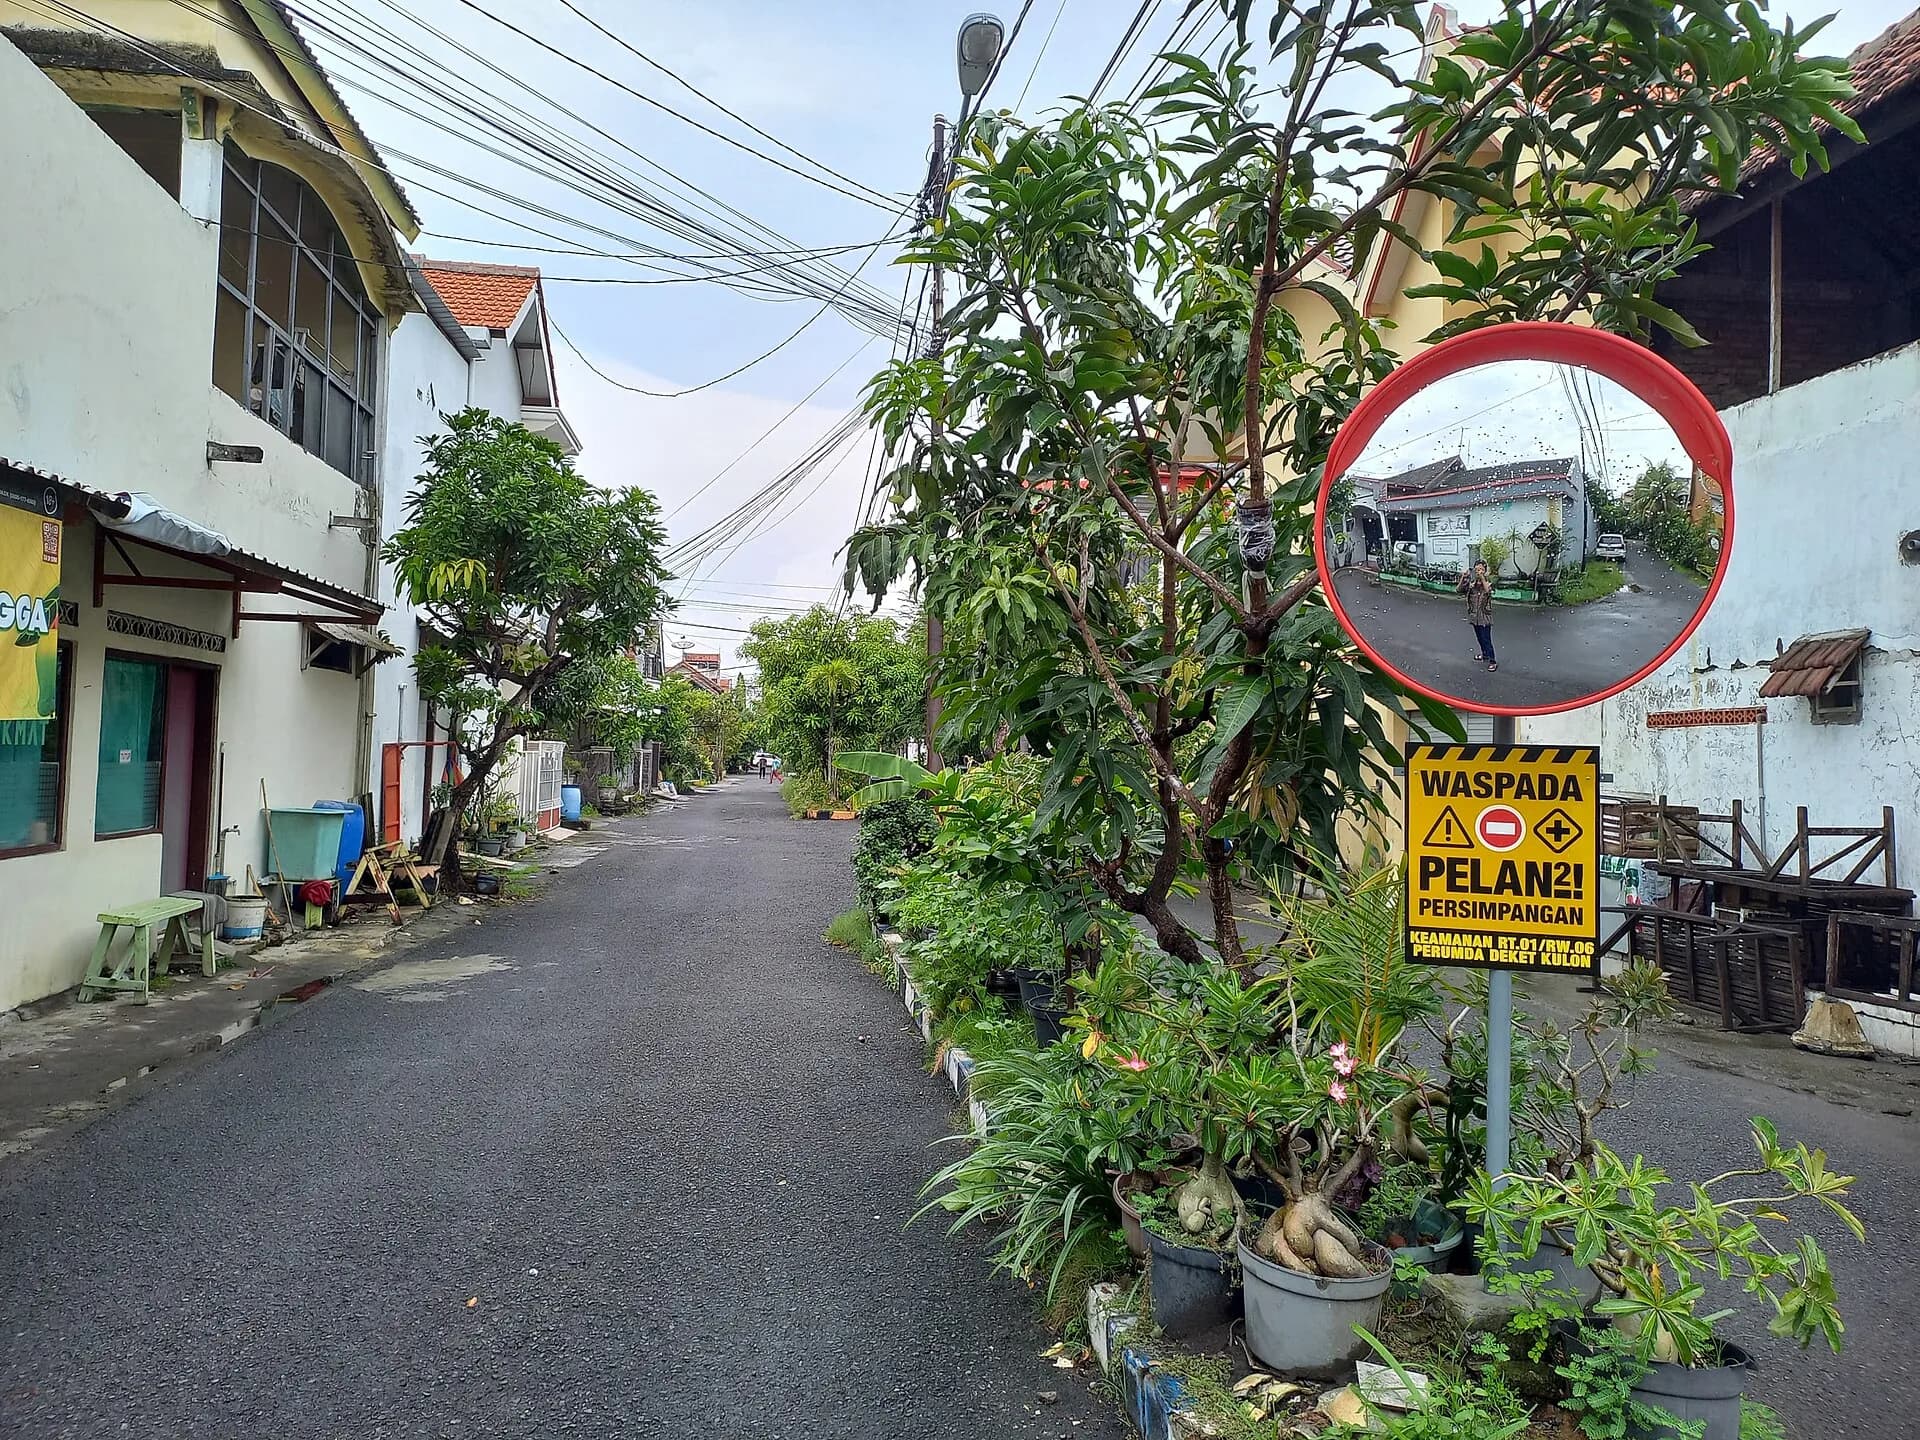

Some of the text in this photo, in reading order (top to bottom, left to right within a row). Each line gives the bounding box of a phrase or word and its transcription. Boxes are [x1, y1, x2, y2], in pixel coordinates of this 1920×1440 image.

[1420, 770, 1584, 802] WASPADA
[1419, 898, 1584, 926] PERSIMPANGAN
[1410, 931, 1595, 955] KEAMANAN RT.01/RW.06
[1413, 943, 1591, 969] PERUMDA DEKET KULON
